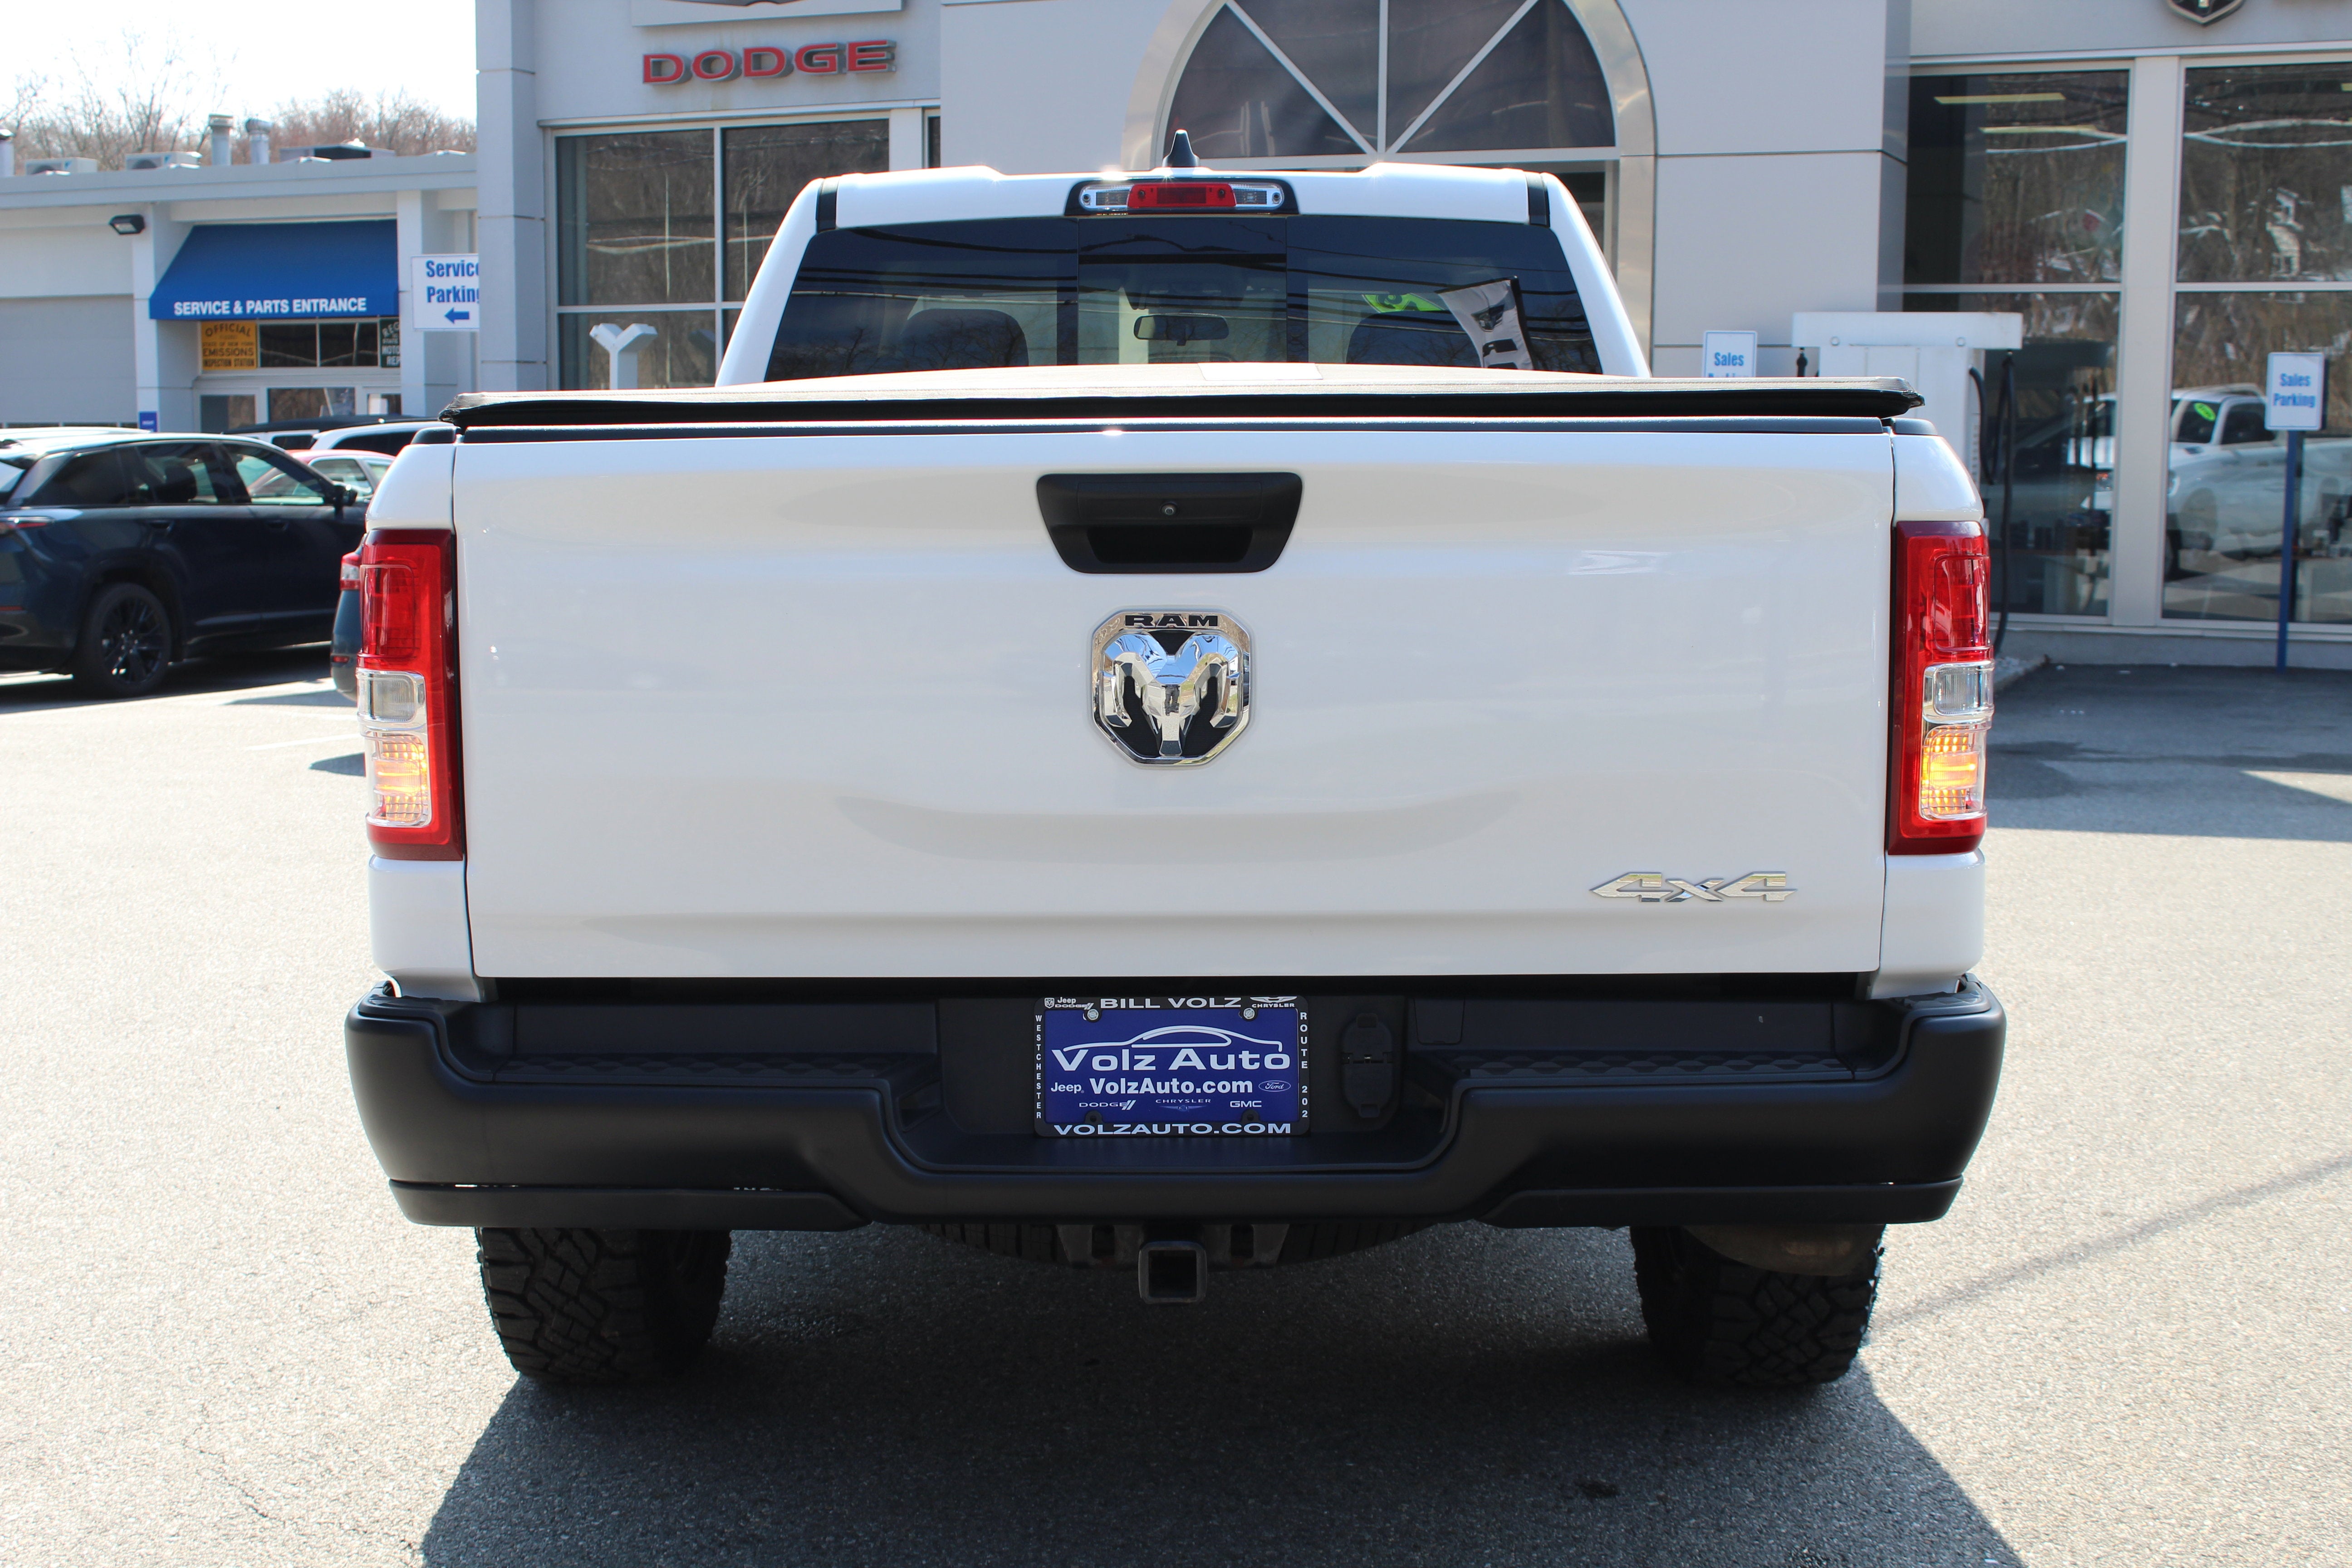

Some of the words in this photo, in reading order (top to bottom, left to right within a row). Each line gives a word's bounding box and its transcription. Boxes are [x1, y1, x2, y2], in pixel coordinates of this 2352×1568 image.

[642, 40, 896, 85] DODGE
[174, 301, 230, 315] SERVICE
[233, 301, 243, 314] &
[246, 299, 289, 313] PARTS
[293, 298, 367, 312] ENTRANCE
[205, 323, 250, 337] OFFICIAL
[203, 348, 254, 356] EMISSIONS
[1714, 352, 1744, 366] Sales
[2279, 372, 2311, 387] Sales
[2273, 392, 2316, 408] Parking
[1124, 614, 1218, 627] RAM
[1589, 871, 1798, 902] 4x4
[1100, 998, 1161, 1009] BILL
[1168, 997, 1241, 1008] VOLZ
[1300, 1012, 1308, 1069] ROUTE
[1052, 1049, 1156, 1071] Volz
[1168, 1048, 1290, 1070] Auto
[1050, 1082, 1082, 1093] Jeep
[1089, 1078, 1253, 1094] VolzAuto.com
[1054, 1122, 1292, 1135] VOLZAUTO.COM
